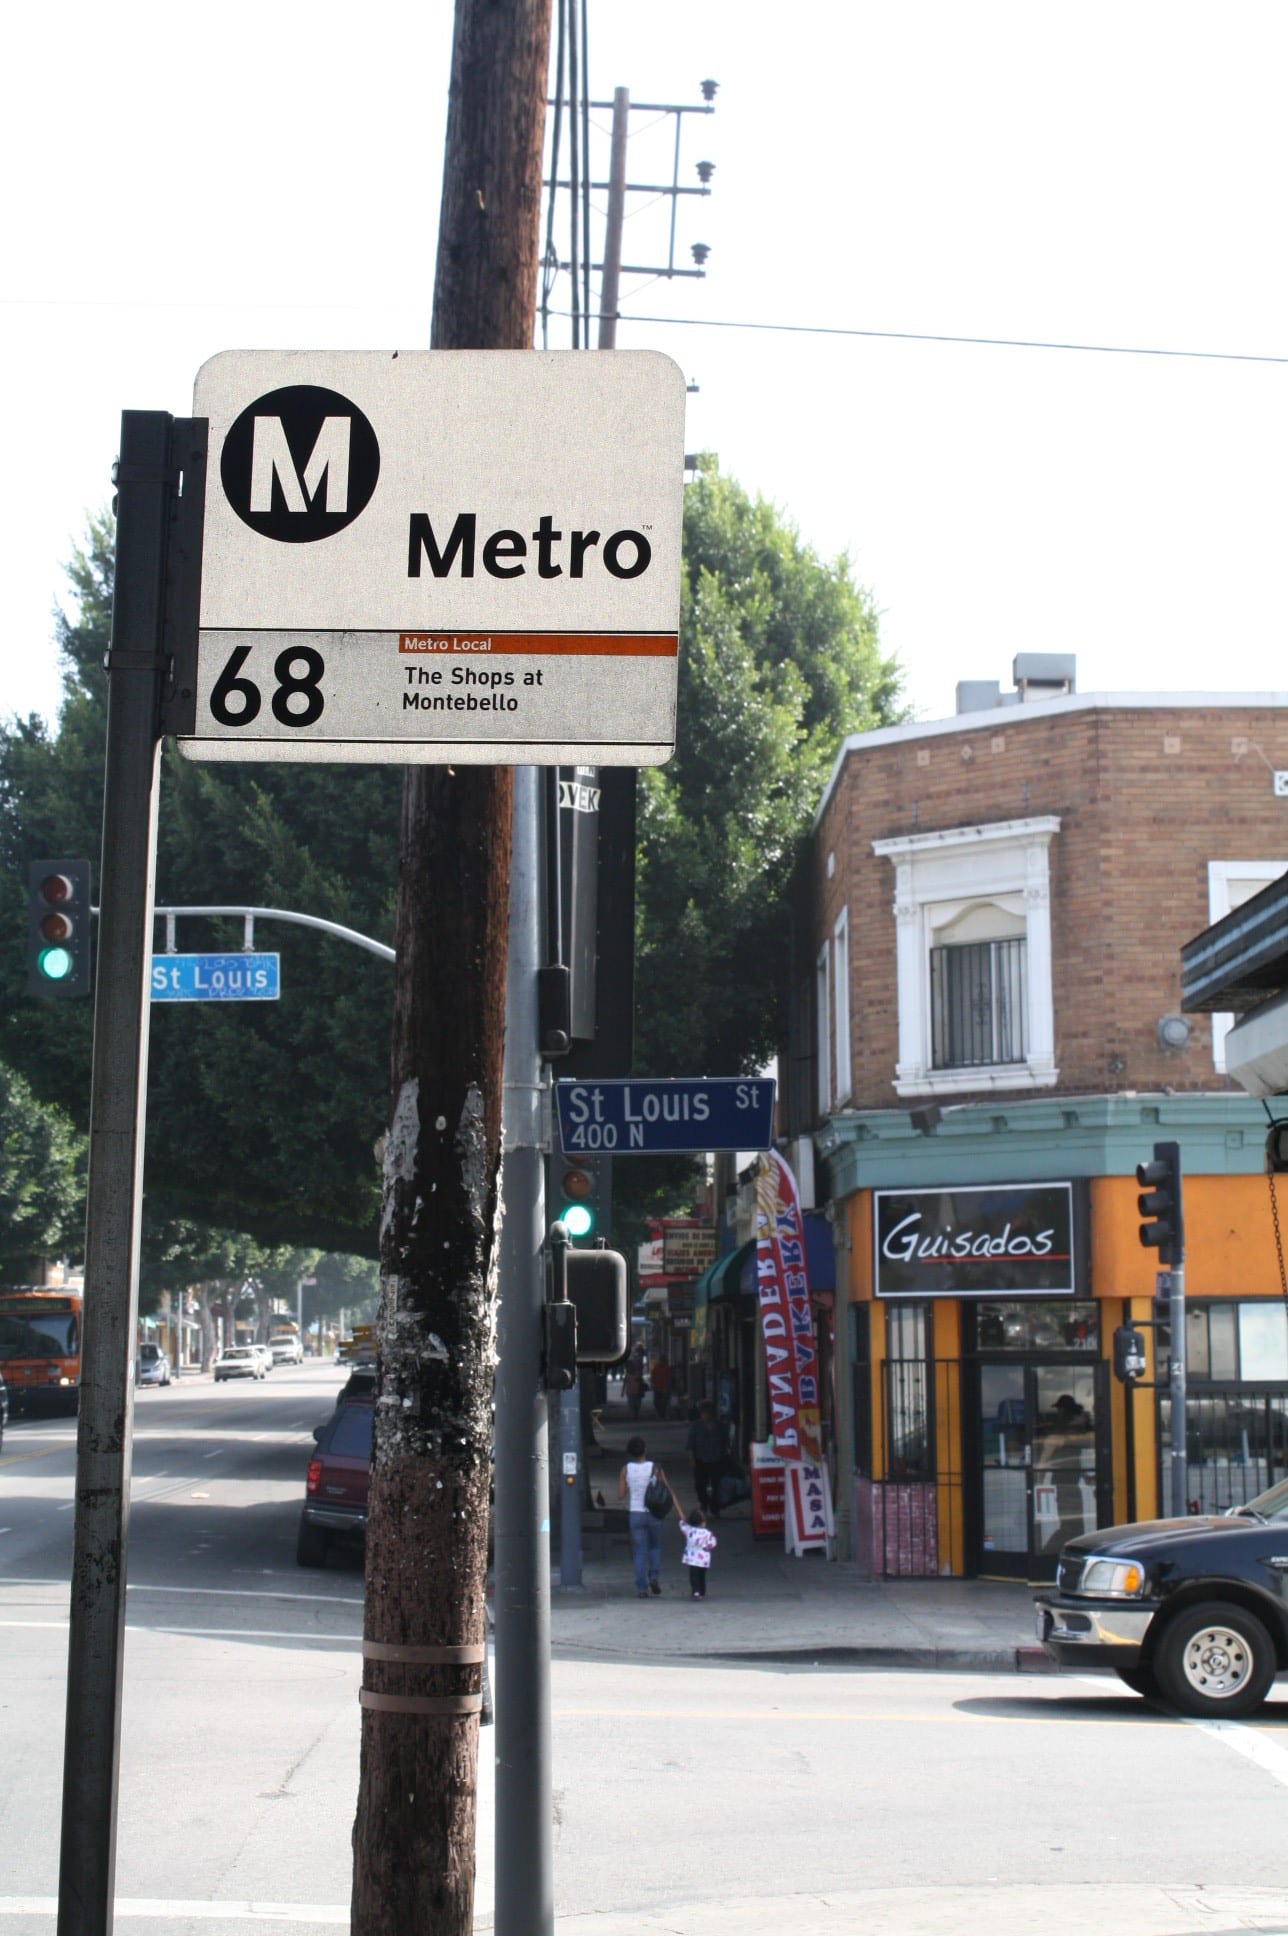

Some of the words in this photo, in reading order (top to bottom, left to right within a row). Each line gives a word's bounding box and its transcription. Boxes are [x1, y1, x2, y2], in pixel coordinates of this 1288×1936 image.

[249, 415, 352, 513] M
[407, 512, 652, 580] Metro
[404, 637, 449, 651] Metro
[452, 637, 492, 651] Local
[209, 644, 326, 728] 68
[405, 666, 443, 685] The
[450, 667, 515, 689] Shops
[523, 669, 544, 686] at
[402, 692, 519, 711] Montebello
[151, 965, 182, 990] St
[193, 965, 268, 989] Louis
[569, 1086, 605, 1123] St
[623, 1086, 711, 1122] Louis
[735, 1084, 760, 1109] St
[570, 1123, 618, 1148] 400
[629, 1123, 644, 1148] N
[882, 1212, 1055, 1263] Guisados
[802, 1465, 826, 1529] MASA
